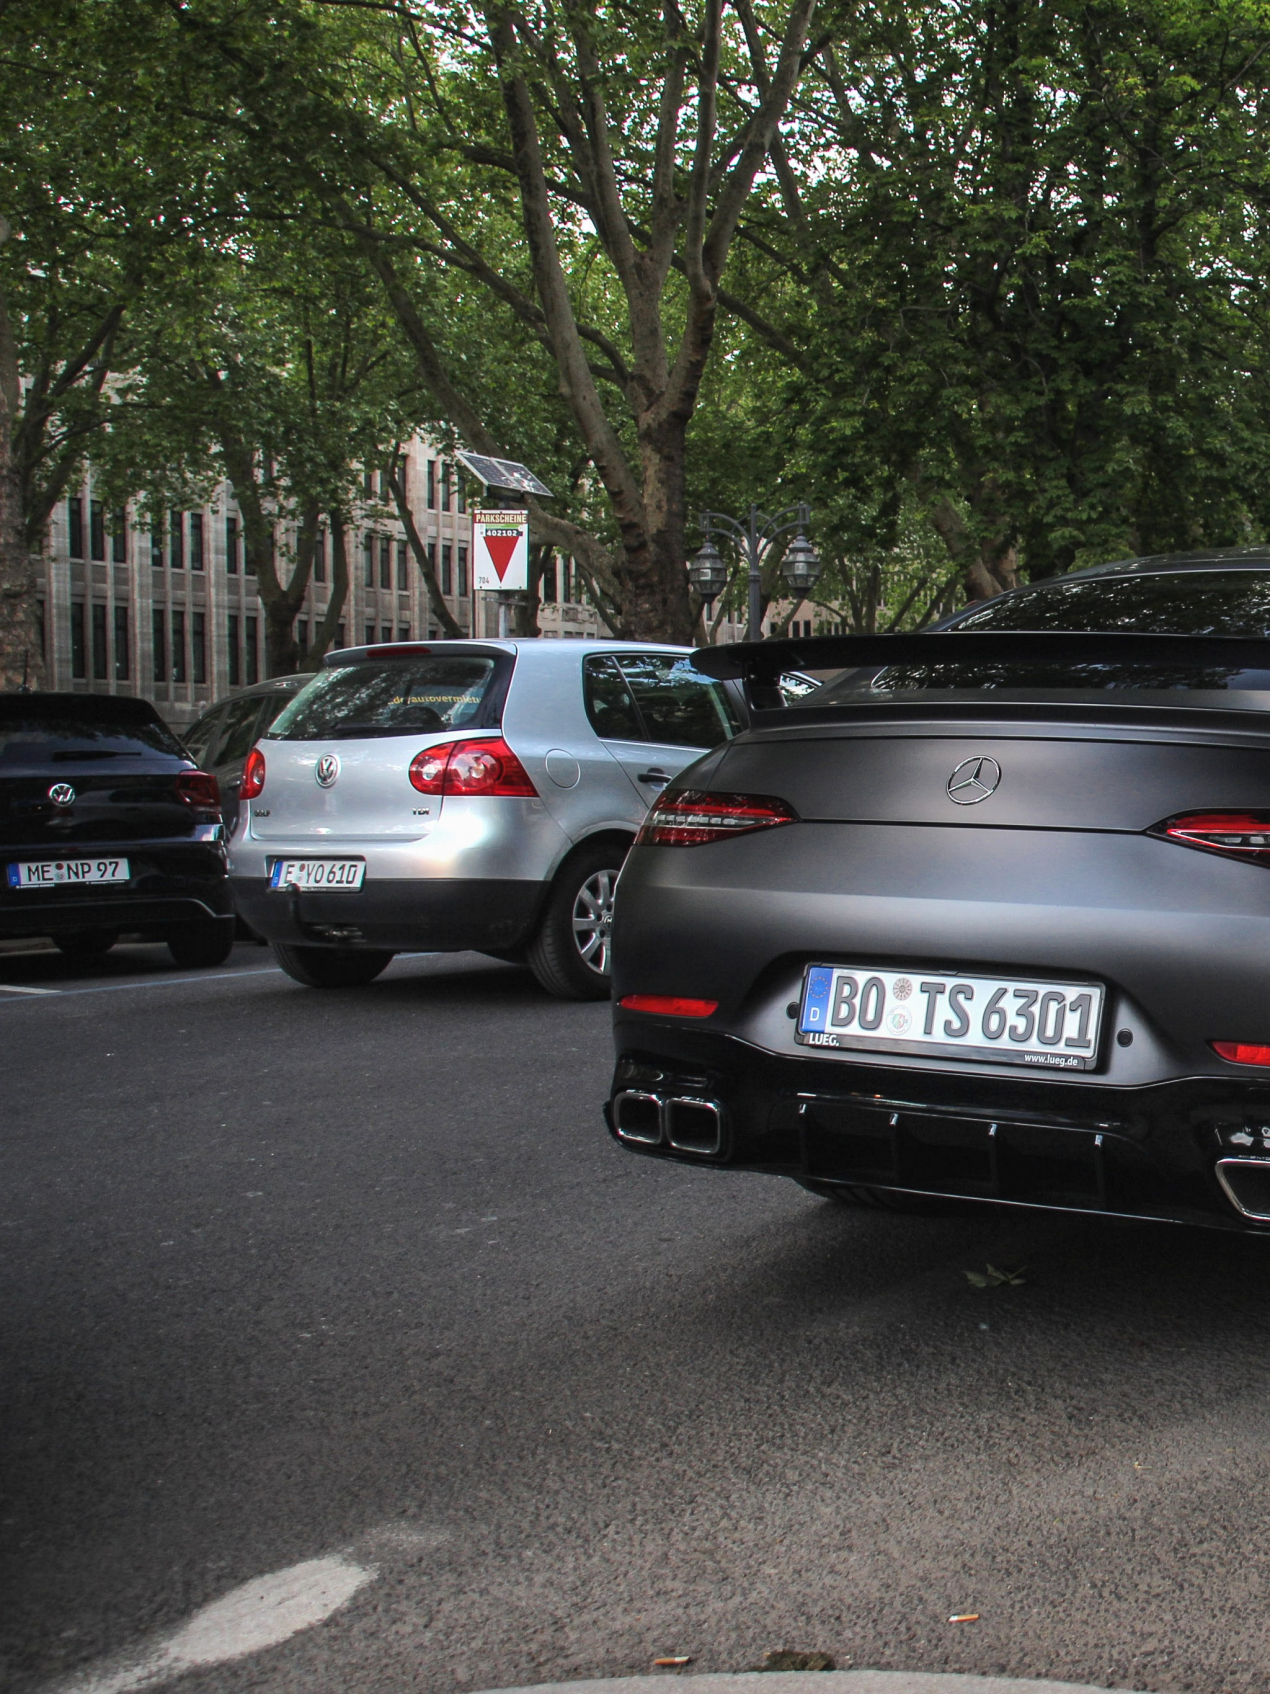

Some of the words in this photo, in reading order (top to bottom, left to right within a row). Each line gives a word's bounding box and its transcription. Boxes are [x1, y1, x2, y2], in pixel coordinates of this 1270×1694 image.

[476, 514, 527, 523] PARKSCHEINE
[486, 529, 518, 537] 402102
[478, 576, 490, 584] 704
[27, 864, 54, 882] ME
[66, 862, 92, 879] NP
[97, 861, 120, 878] 97
[284, 863, 296, 884] E
[306, 863, 325, 884] YO
[327, 863, 359, 884] 610
[831, 976, 886, 1030] BO
[920, 981, 974, 1037] TS
[981, 988, 1092, 1048] 6301
[809, 1032, 840, 1046] LUEG.
[1024, 1053, 1078, 1067] www.lueg.de
